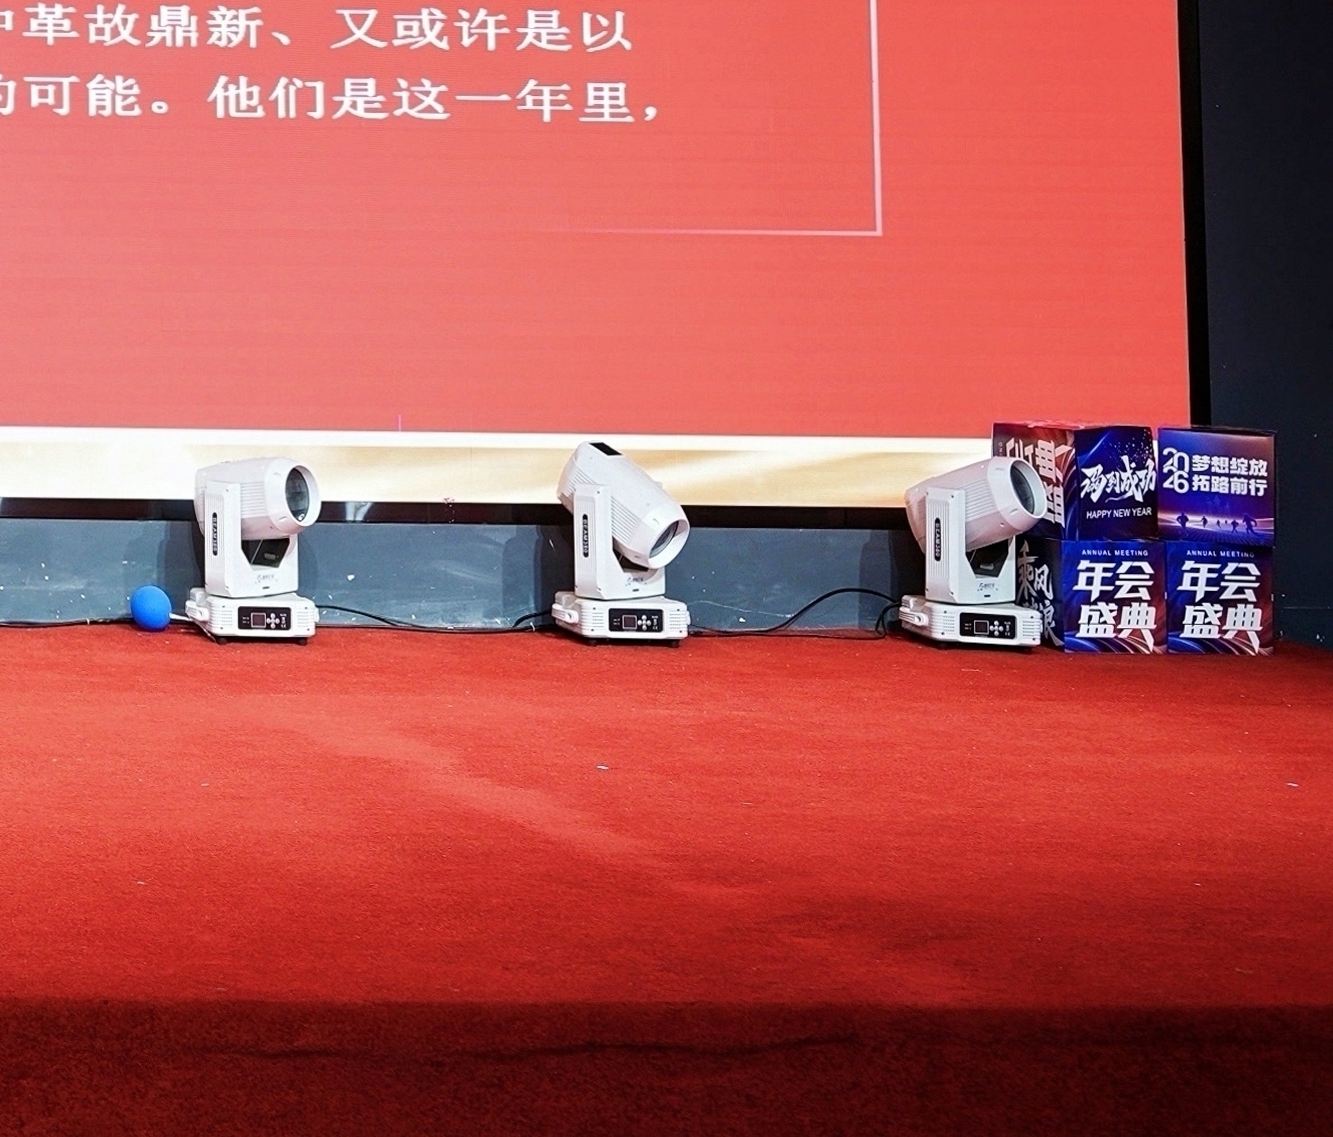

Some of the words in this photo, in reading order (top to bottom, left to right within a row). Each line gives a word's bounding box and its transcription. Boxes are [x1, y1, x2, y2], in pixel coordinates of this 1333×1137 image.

[1191, 454, 1268, 477] 梦想绽放
[1191, 474, 1268, 497] 拓路前行
[1086, 511, 1111, 520] HAPPY
[1113, 509, 1131, 518] NEW
[1132, 507, 1153, 516] YEAR
[1186, 549, 1217, 557] ANNUAL
[1219, 550, 1255, 558] MEETING
[1072, 559, 1155, 602] 年会
[1176, 560, 1262, 603] 年会
[1075, 601, 1158, 653] 盛典
[1179, 602, 1264, 654] 盛典
